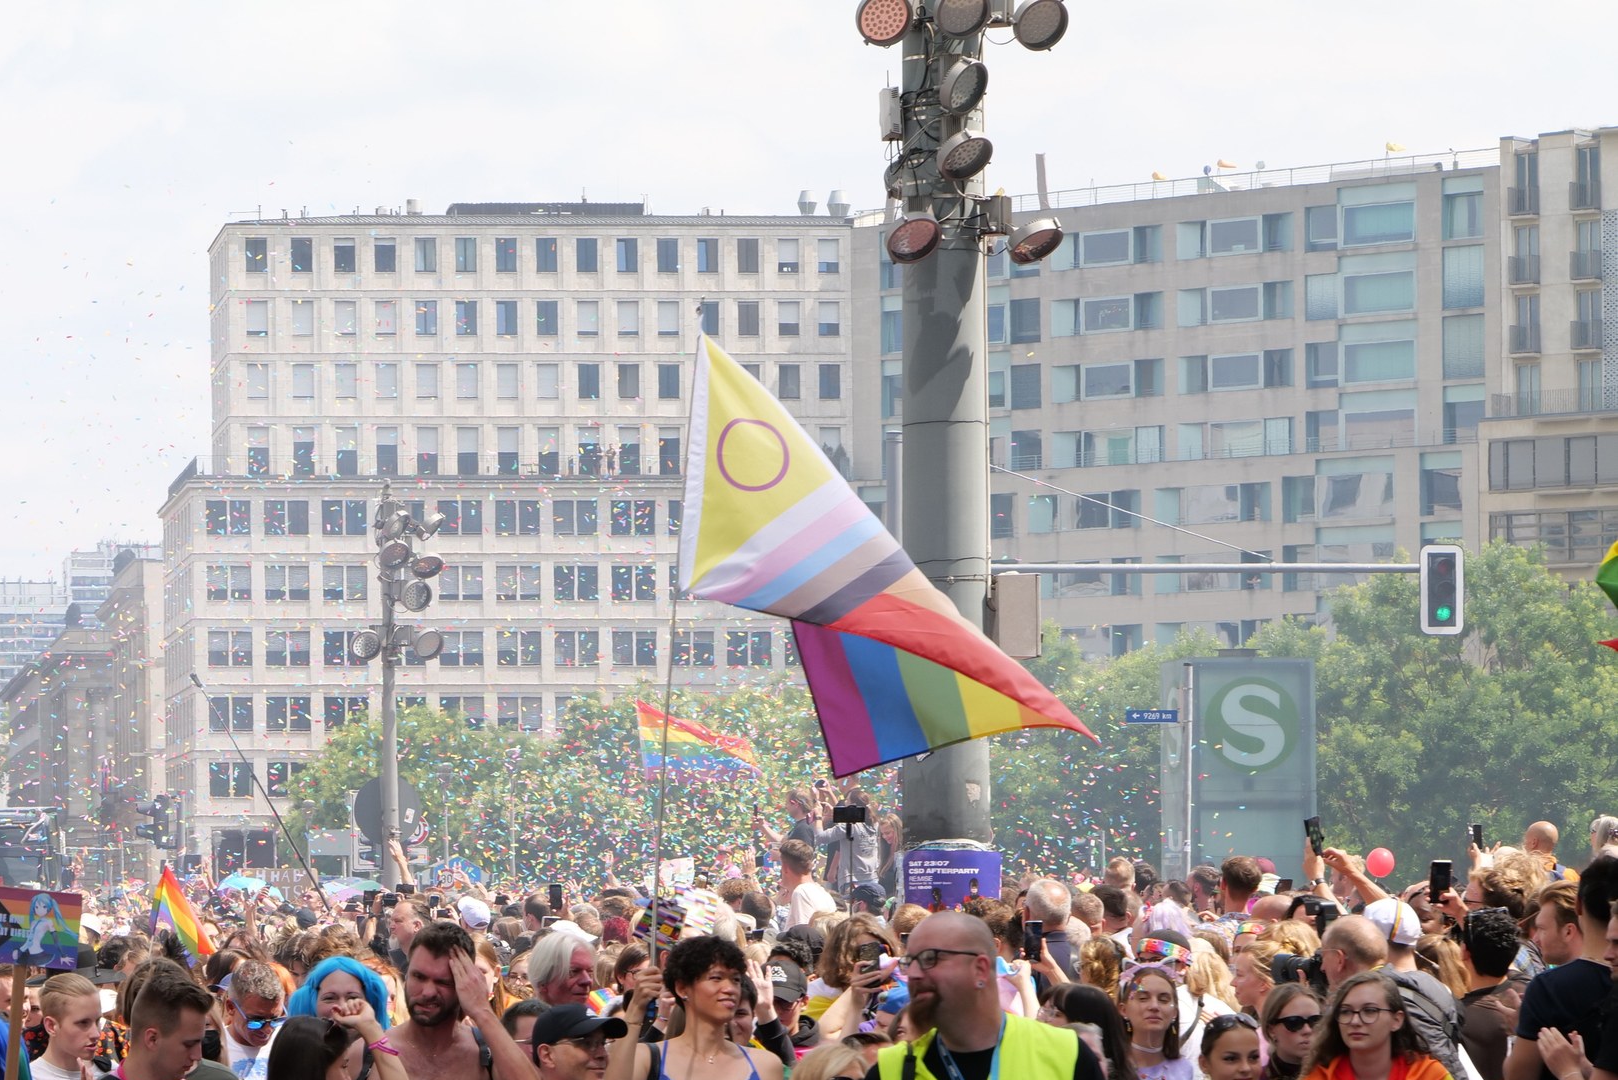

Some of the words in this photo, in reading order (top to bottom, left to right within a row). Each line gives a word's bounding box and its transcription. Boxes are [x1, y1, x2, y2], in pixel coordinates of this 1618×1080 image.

[1143, 712, 1160, 720] 9269
[1162, 711, 1172, 720] km
[1220, 684, 1285, 767] S
[440, 873, 453, 884] 30
